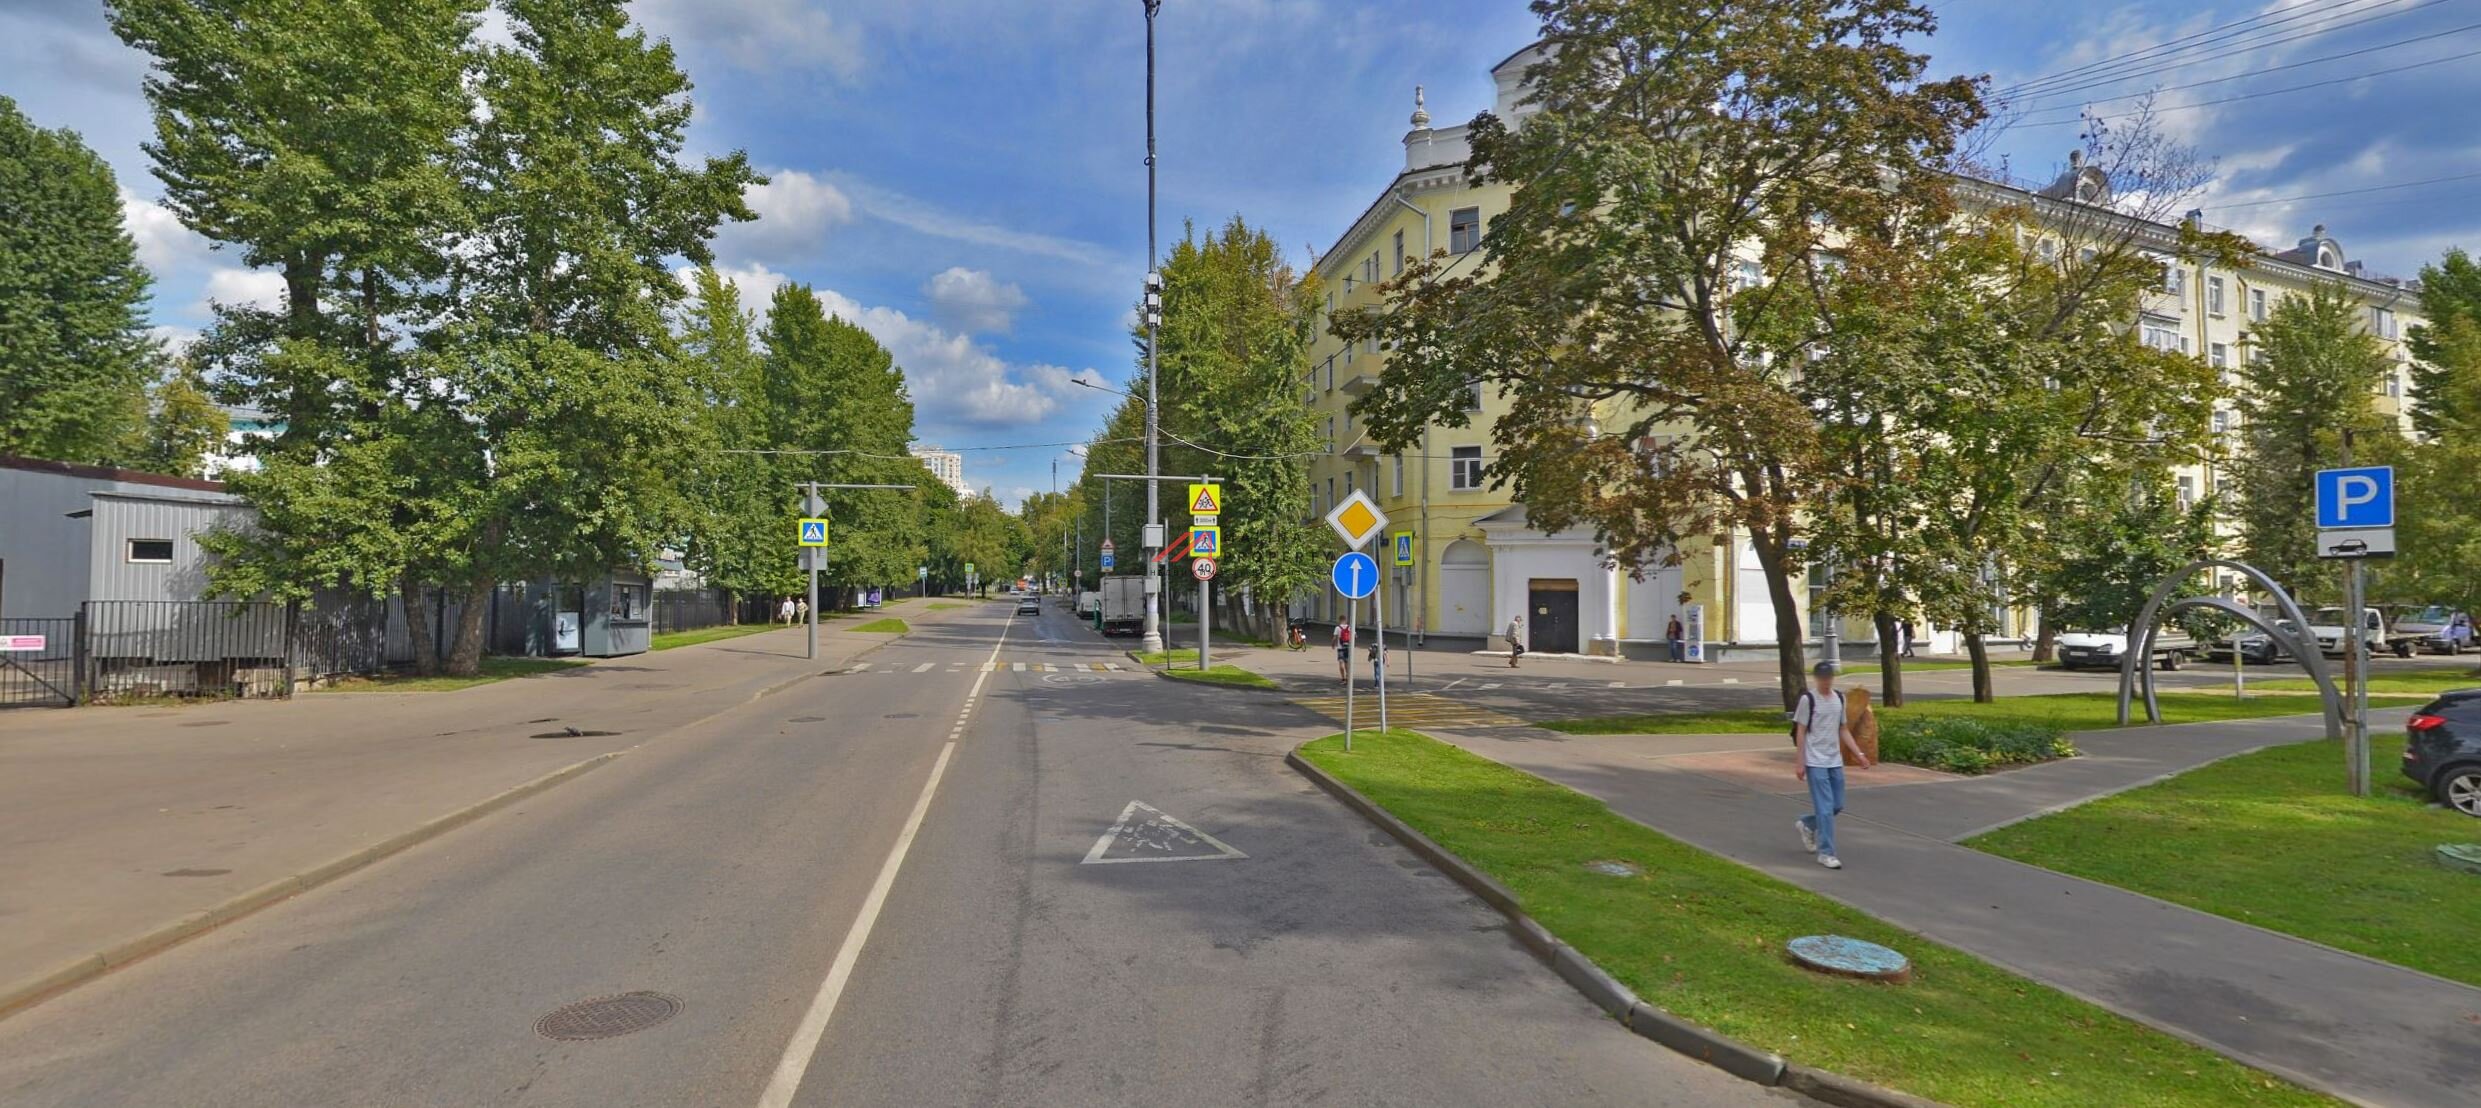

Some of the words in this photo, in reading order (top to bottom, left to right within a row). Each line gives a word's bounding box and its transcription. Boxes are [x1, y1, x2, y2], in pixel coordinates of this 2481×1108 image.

[2337, 475, 2378, 521] P
[1104, 557, 1111, 566] P
[1197, 563, 1211, 572] 40
